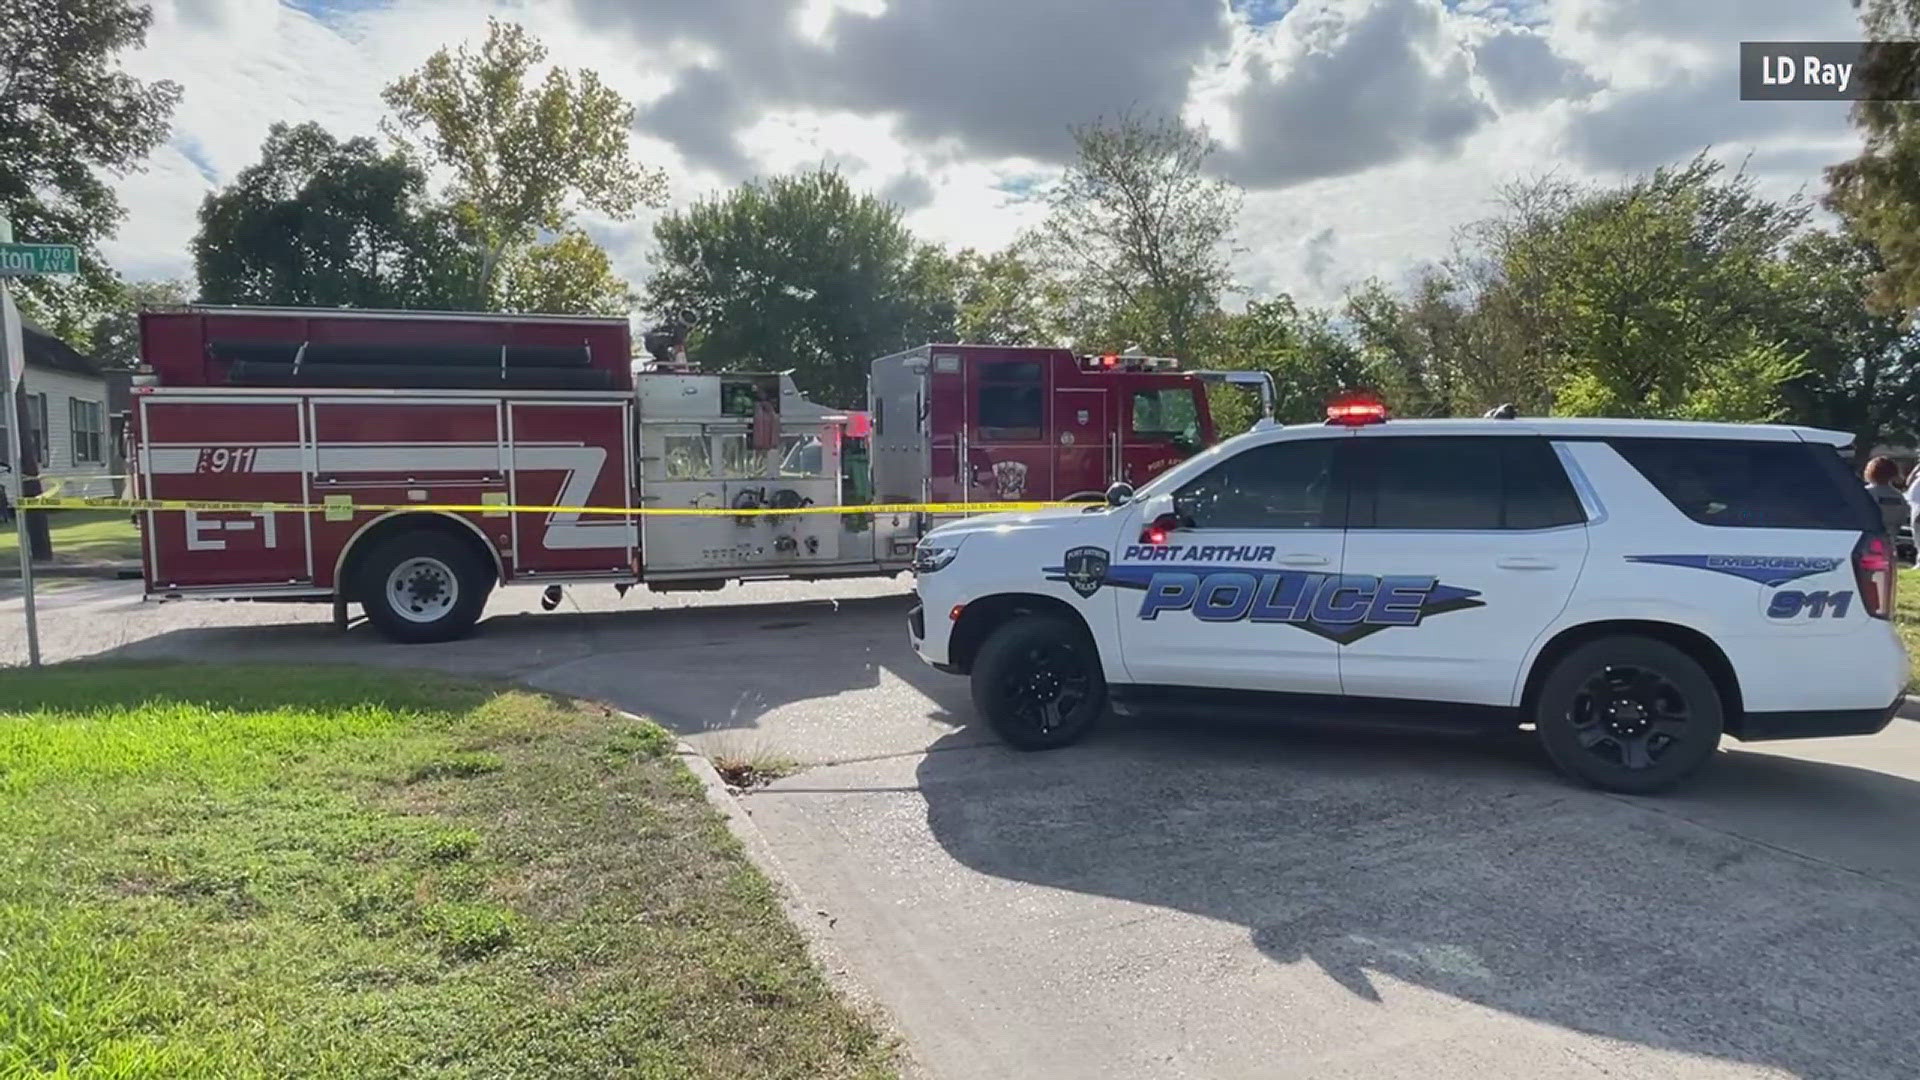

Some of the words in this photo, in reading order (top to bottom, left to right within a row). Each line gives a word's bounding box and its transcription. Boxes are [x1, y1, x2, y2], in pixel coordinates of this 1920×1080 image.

[0, 247, 36, 270] ton
[43, 260, 69, 272] AVE
[211, 448, 255, 473] 911
[185, 502, 277, 551] E-1
[1123, 545, 1184, 561] PORT
[1182, 545, 1276, 562] ARTHUR
[1706, 554, 1845, 571] EMERGENCY
[1138, 572, 1438, 627] POLICE
[1766, 590, 1854, 619] 911
